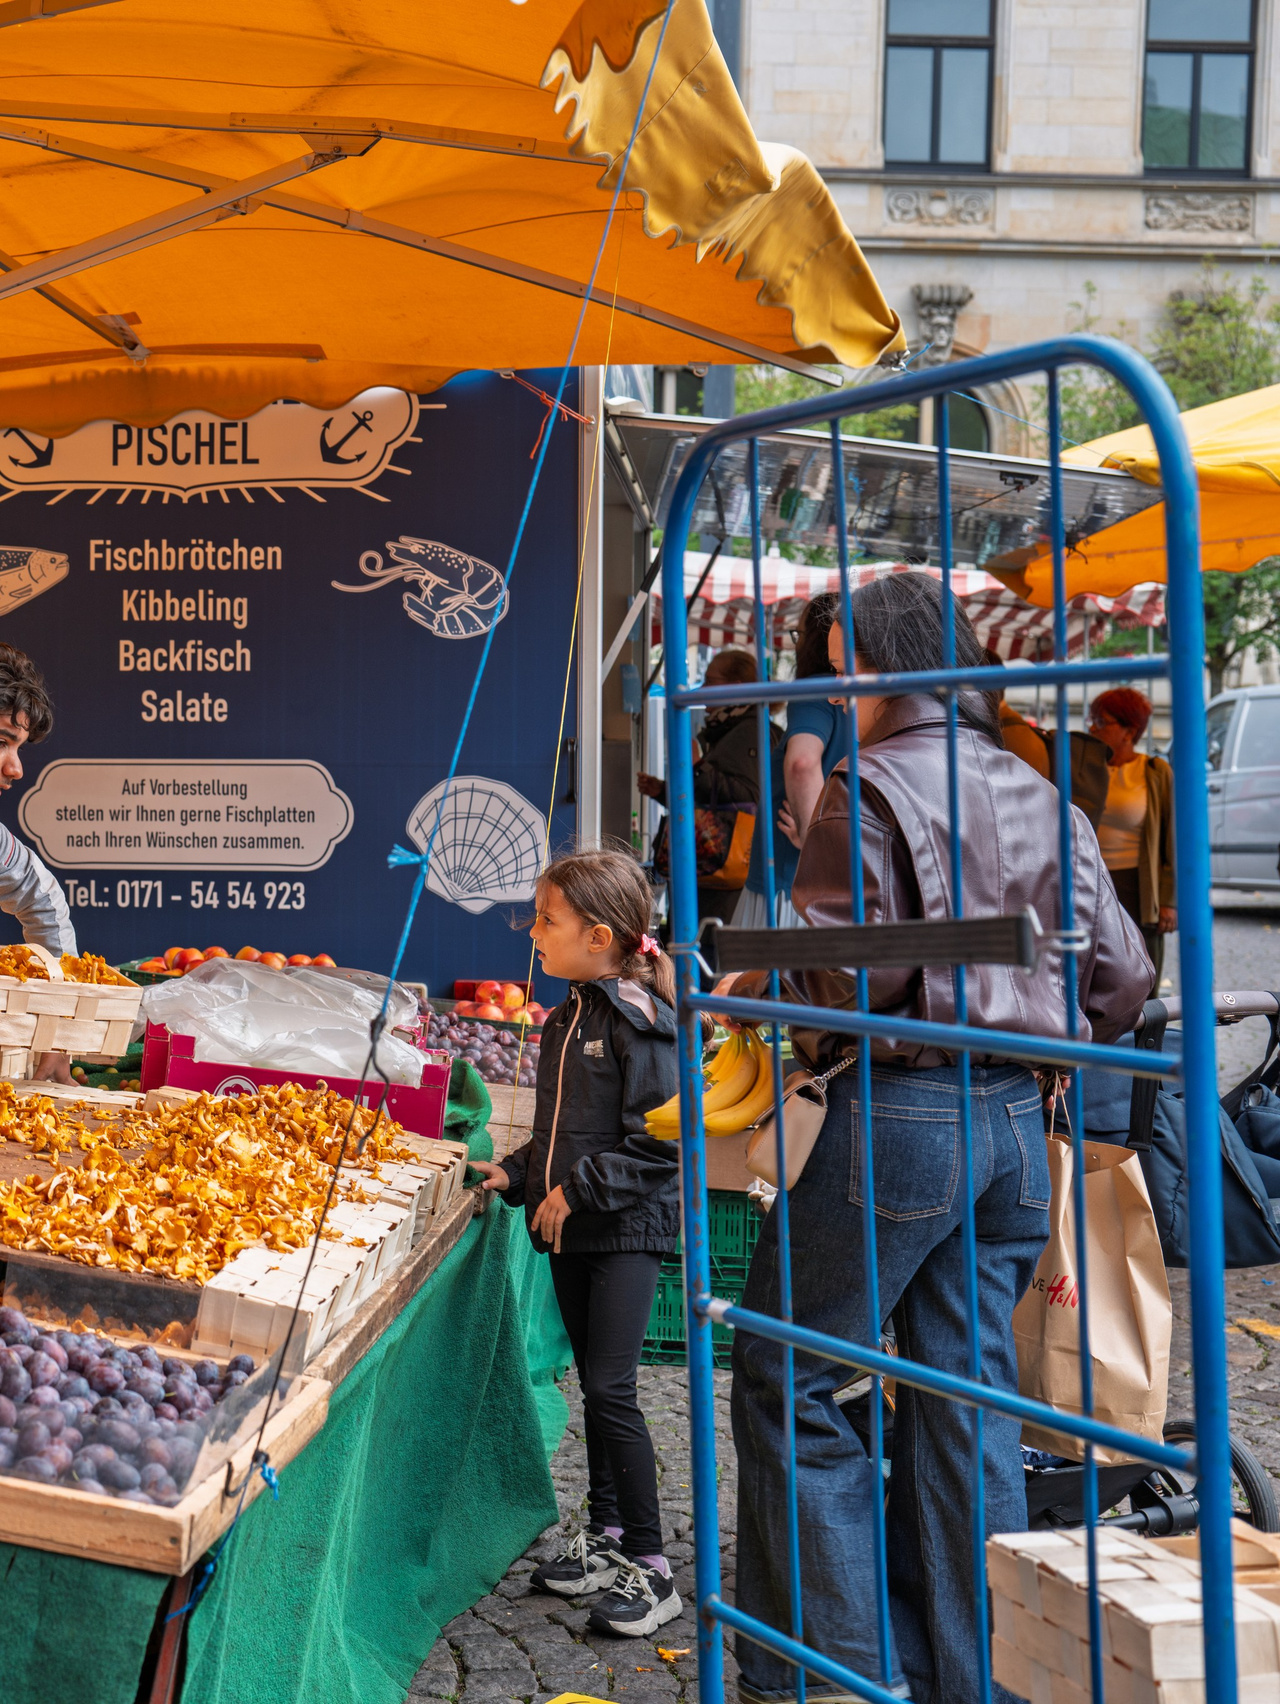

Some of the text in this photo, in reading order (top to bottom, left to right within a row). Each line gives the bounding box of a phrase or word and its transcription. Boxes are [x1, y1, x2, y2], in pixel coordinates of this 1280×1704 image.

[112, 421, 260, 466] PISCHEL
[89, 538, 282, 571] Fischbrötchen
[122, 589, 248, 629] Kibbeling
[119, 639, 251, 672] Backfisch
[141, 689, 228, 722] Salate
[122, 779, 248, 800] Auf Vorbestellung
[55, 805, 315, 827] stellen wir Ihnen gerne Fischplatten
[66, 831, 305, 850] nach Ihren Wünschen zusammen.
[65, 879, 109, 908] Tel.:
[117, 879, 163, 908] 0171
[190, 881, 220, 909] 54
[227, 881, 257, 909] 54
[264, 881, 306, 910] 923
